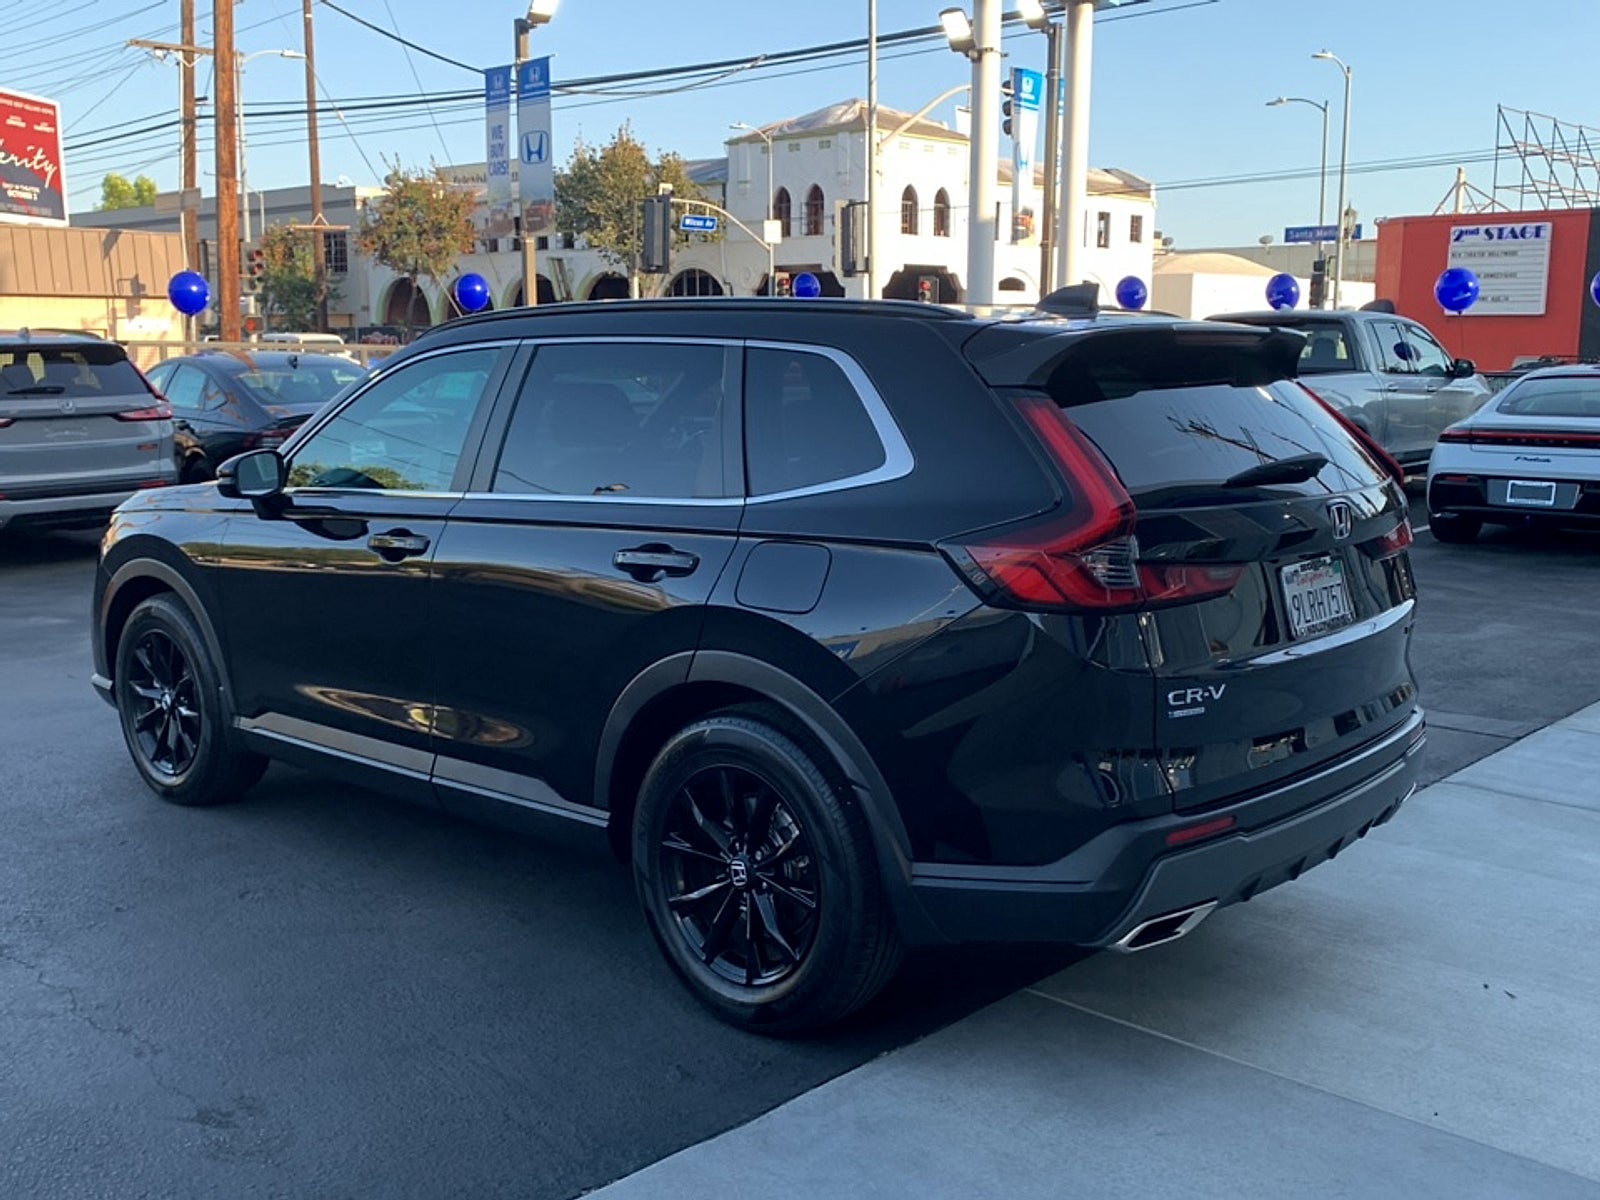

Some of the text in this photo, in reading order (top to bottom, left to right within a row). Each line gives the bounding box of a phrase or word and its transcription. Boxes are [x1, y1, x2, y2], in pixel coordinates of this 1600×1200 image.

[491, 125, 504, 140] WE
[490, 143, 506, 159] BUY
[1453, 224, 1547, 243] 2nd STAGE
[1291, 583, 1345, 627] 9LRH757
[1168, 683, 1226, 706] CR-V
